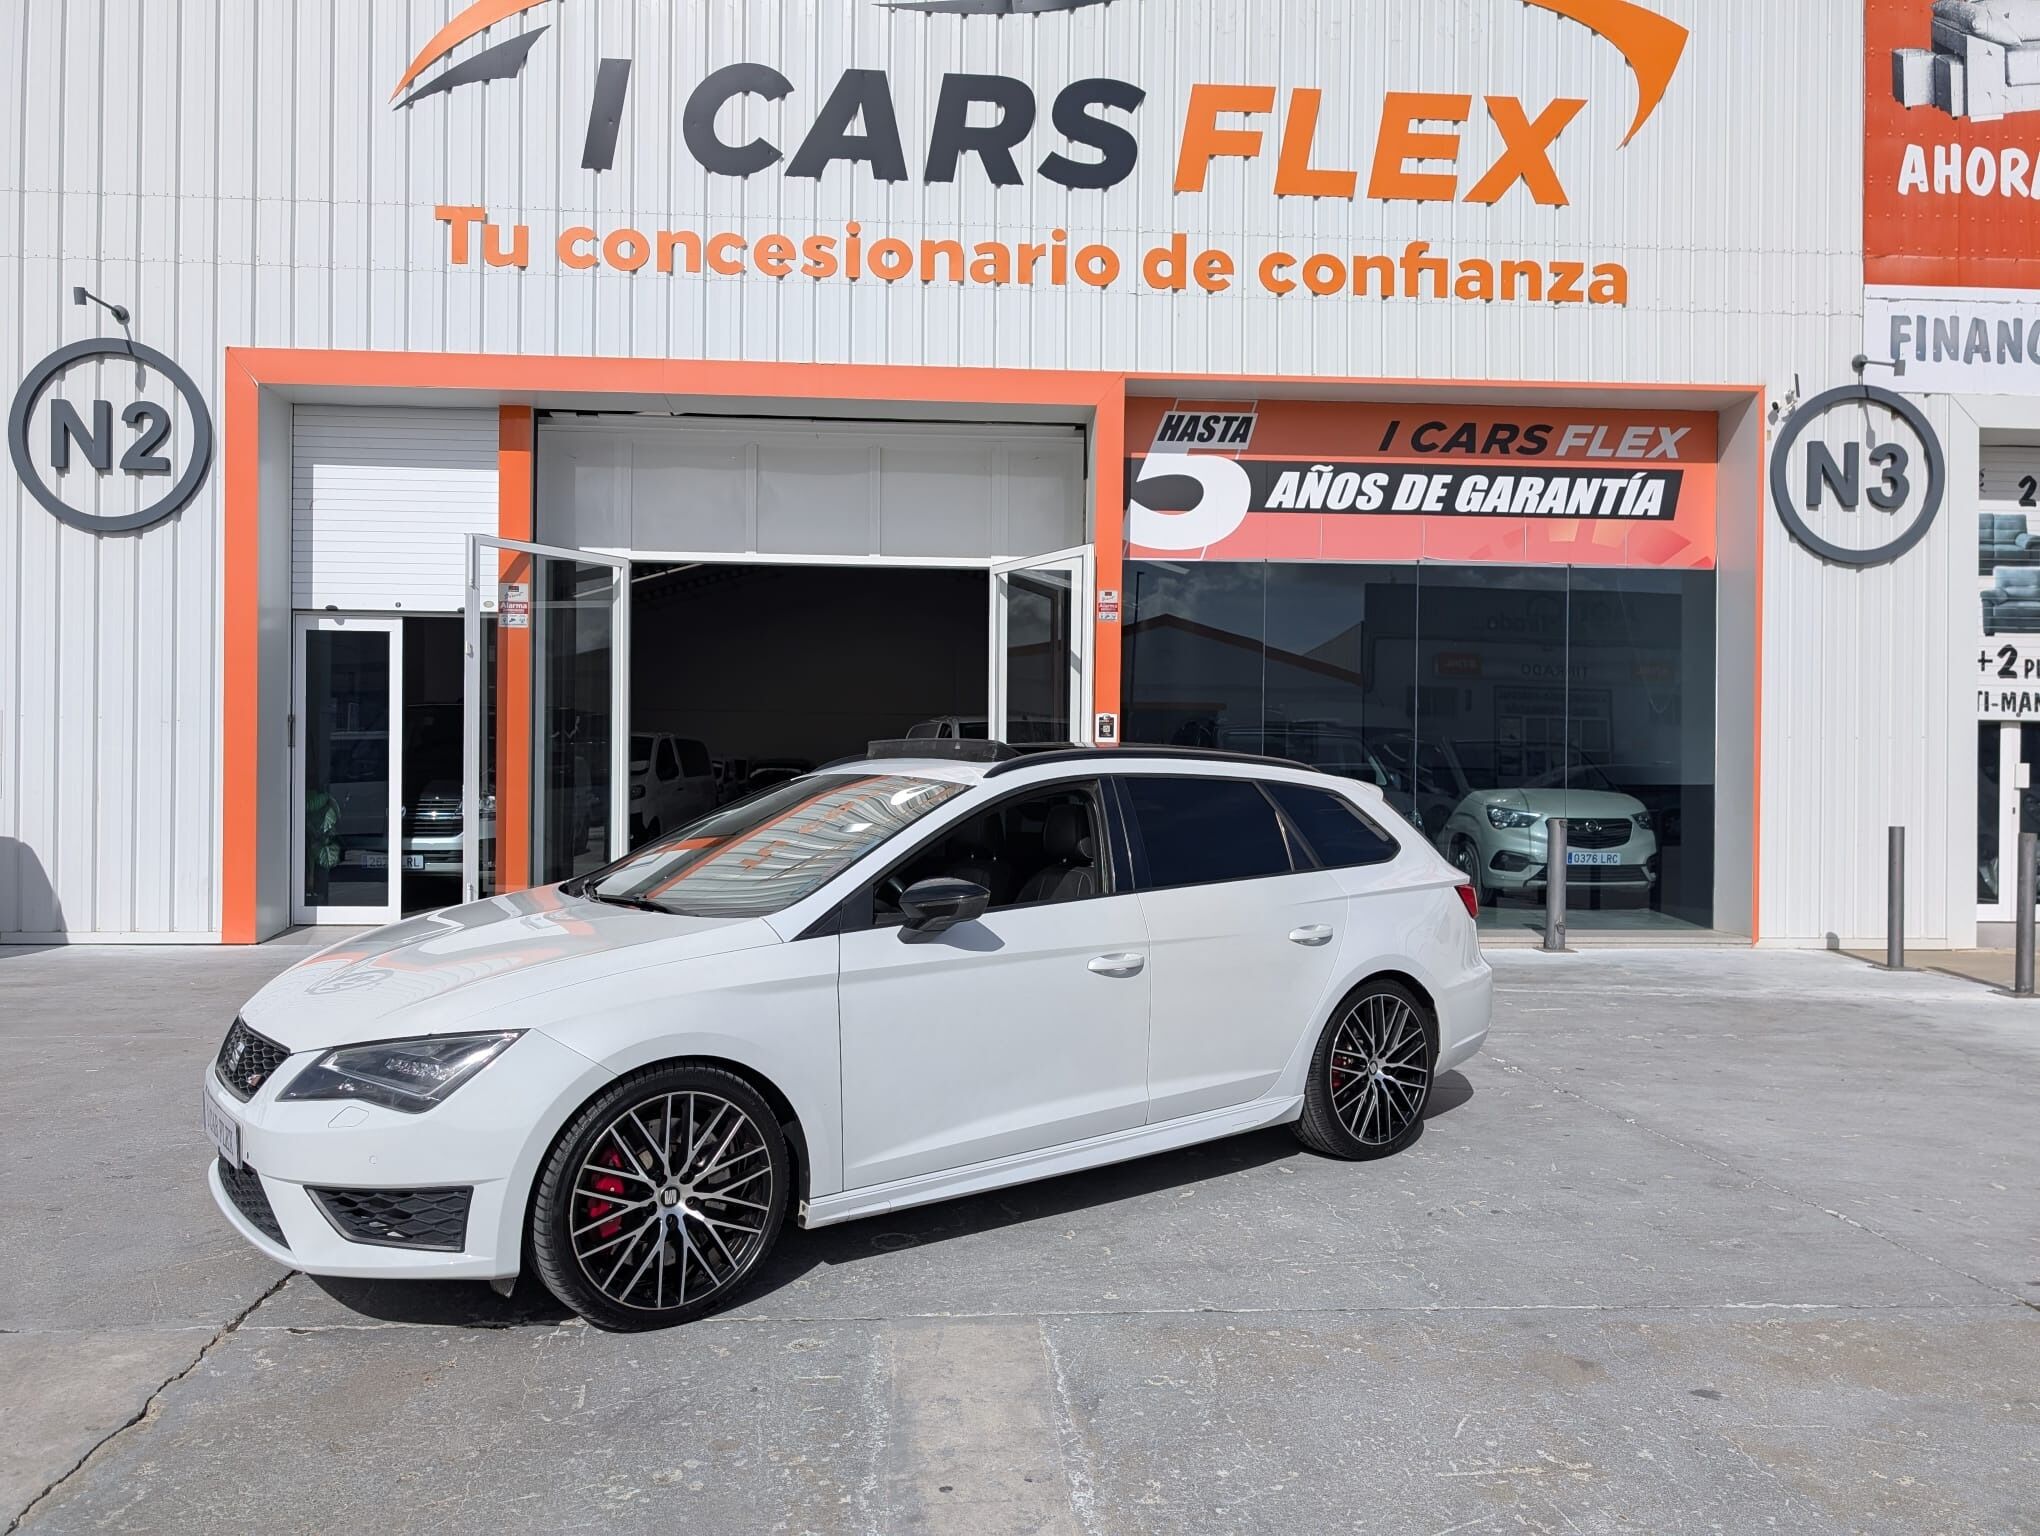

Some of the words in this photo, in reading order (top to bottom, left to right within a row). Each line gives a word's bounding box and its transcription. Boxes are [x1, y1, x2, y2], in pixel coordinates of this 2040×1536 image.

[581, 58, 632, 171] I
[682, 62, 1146, 189] CARS
[1173, 84, 1589, 206] FLEX
[434, 204, 529, 267] Tu
[557, 221, 1121, 287] concesionario
[1142, 233, 1236, 293] de
[1258, 241, 1629, 305] confianza
[50, 398, 172, 471] N2
[1156, 414, 1254, 443] HASTA
[1378, 420, 1400, 452] I
[1410, 420, 1554, 456] CARS
[1555, 424, 1692, 459] FLEX
[1124, 411, 1258, 551] 5
[1264, 464, 1389, 511] AÑOS
[1391, 473, 1453, 512] DE
[1454, 472, 1666, 517] GARANTÍA
[1806, 440, 1910, 508] N3
[1573, 853, 1599, 864] 0376
[1600, 854, 1618, 864] LRC
